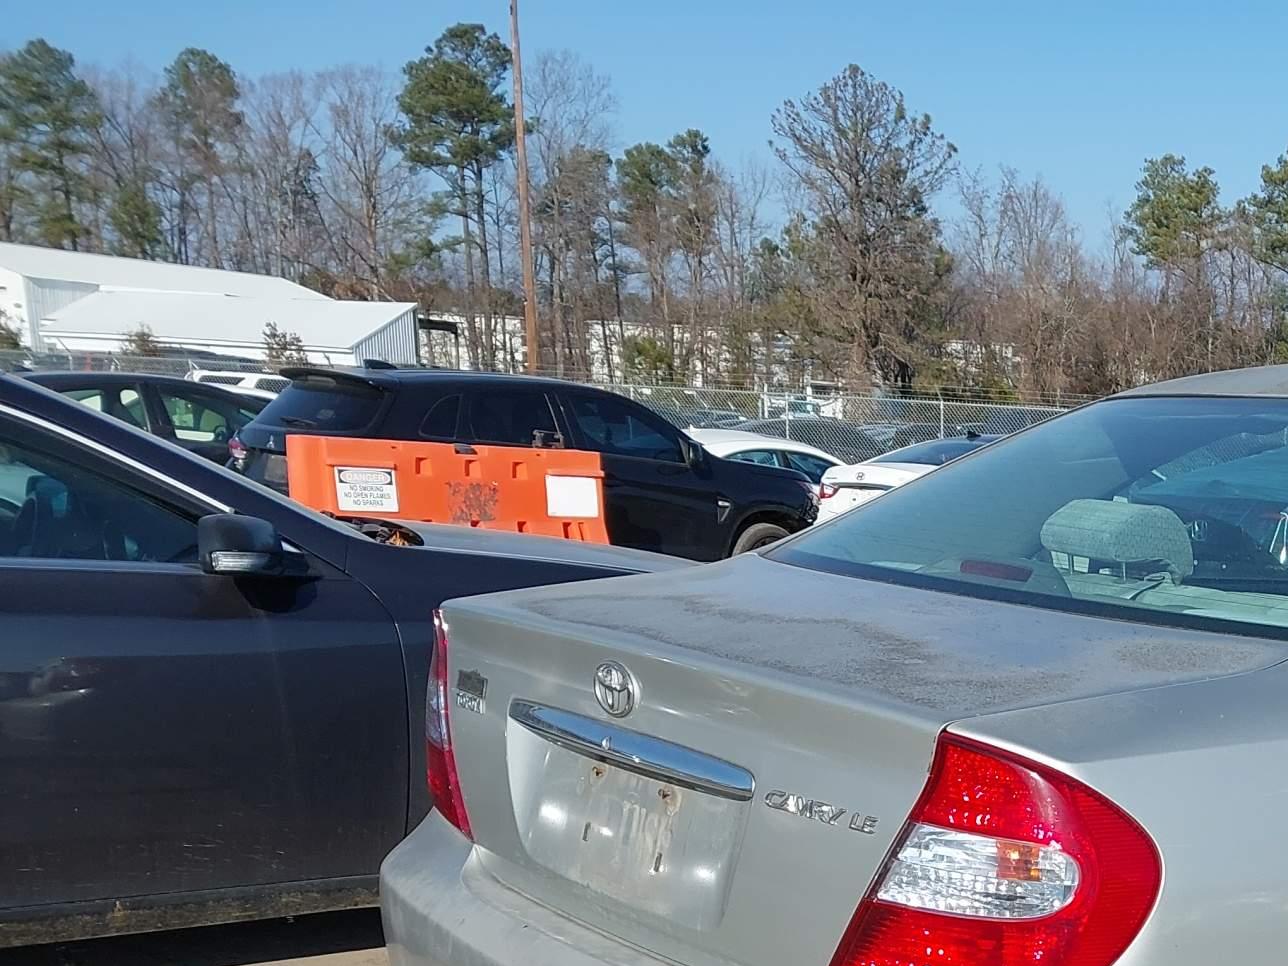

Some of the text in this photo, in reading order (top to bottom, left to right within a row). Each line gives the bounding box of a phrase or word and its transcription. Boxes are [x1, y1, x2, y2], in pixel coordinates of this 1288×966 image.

[345, 472, 386, 482] DANGER
[362, 499, 384, 507] SPARKS
[848, 812, 879, 835] LE
